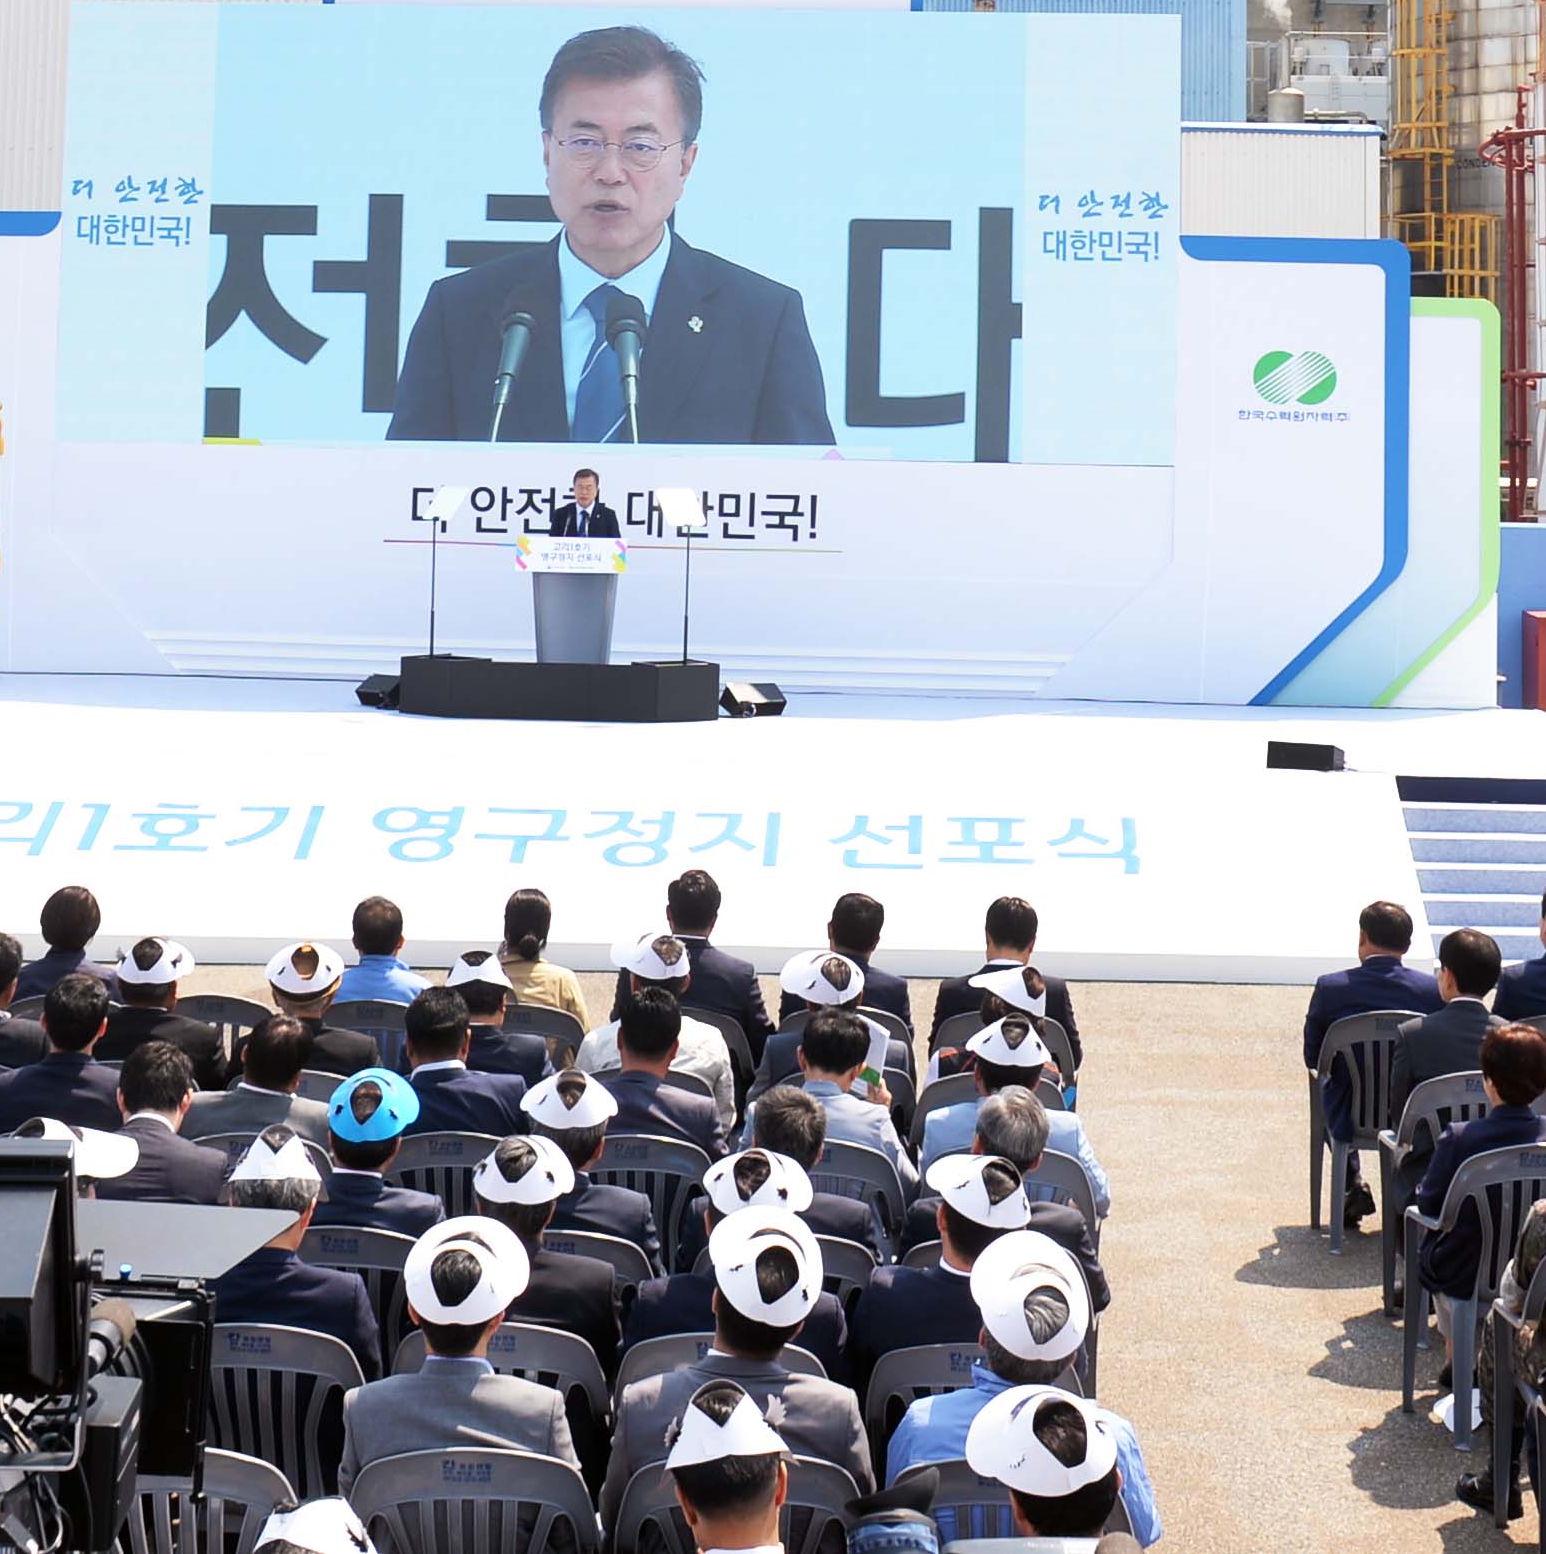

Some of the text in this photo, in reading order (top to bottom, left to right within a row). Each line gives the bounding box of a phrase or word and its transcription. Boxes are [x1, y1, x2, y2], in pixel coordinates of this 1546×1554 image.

[71, 174, 204, 205] 더 안전한
[1038, 189, 1169, 219] 더 안전한
[76, 214, 192, 247] 대한민국!
[1042, 229, 1160, 263] 대한민국!
[372, 804, 781, 868] 영구정지
[829, 813, 1141, 875] 선포식
